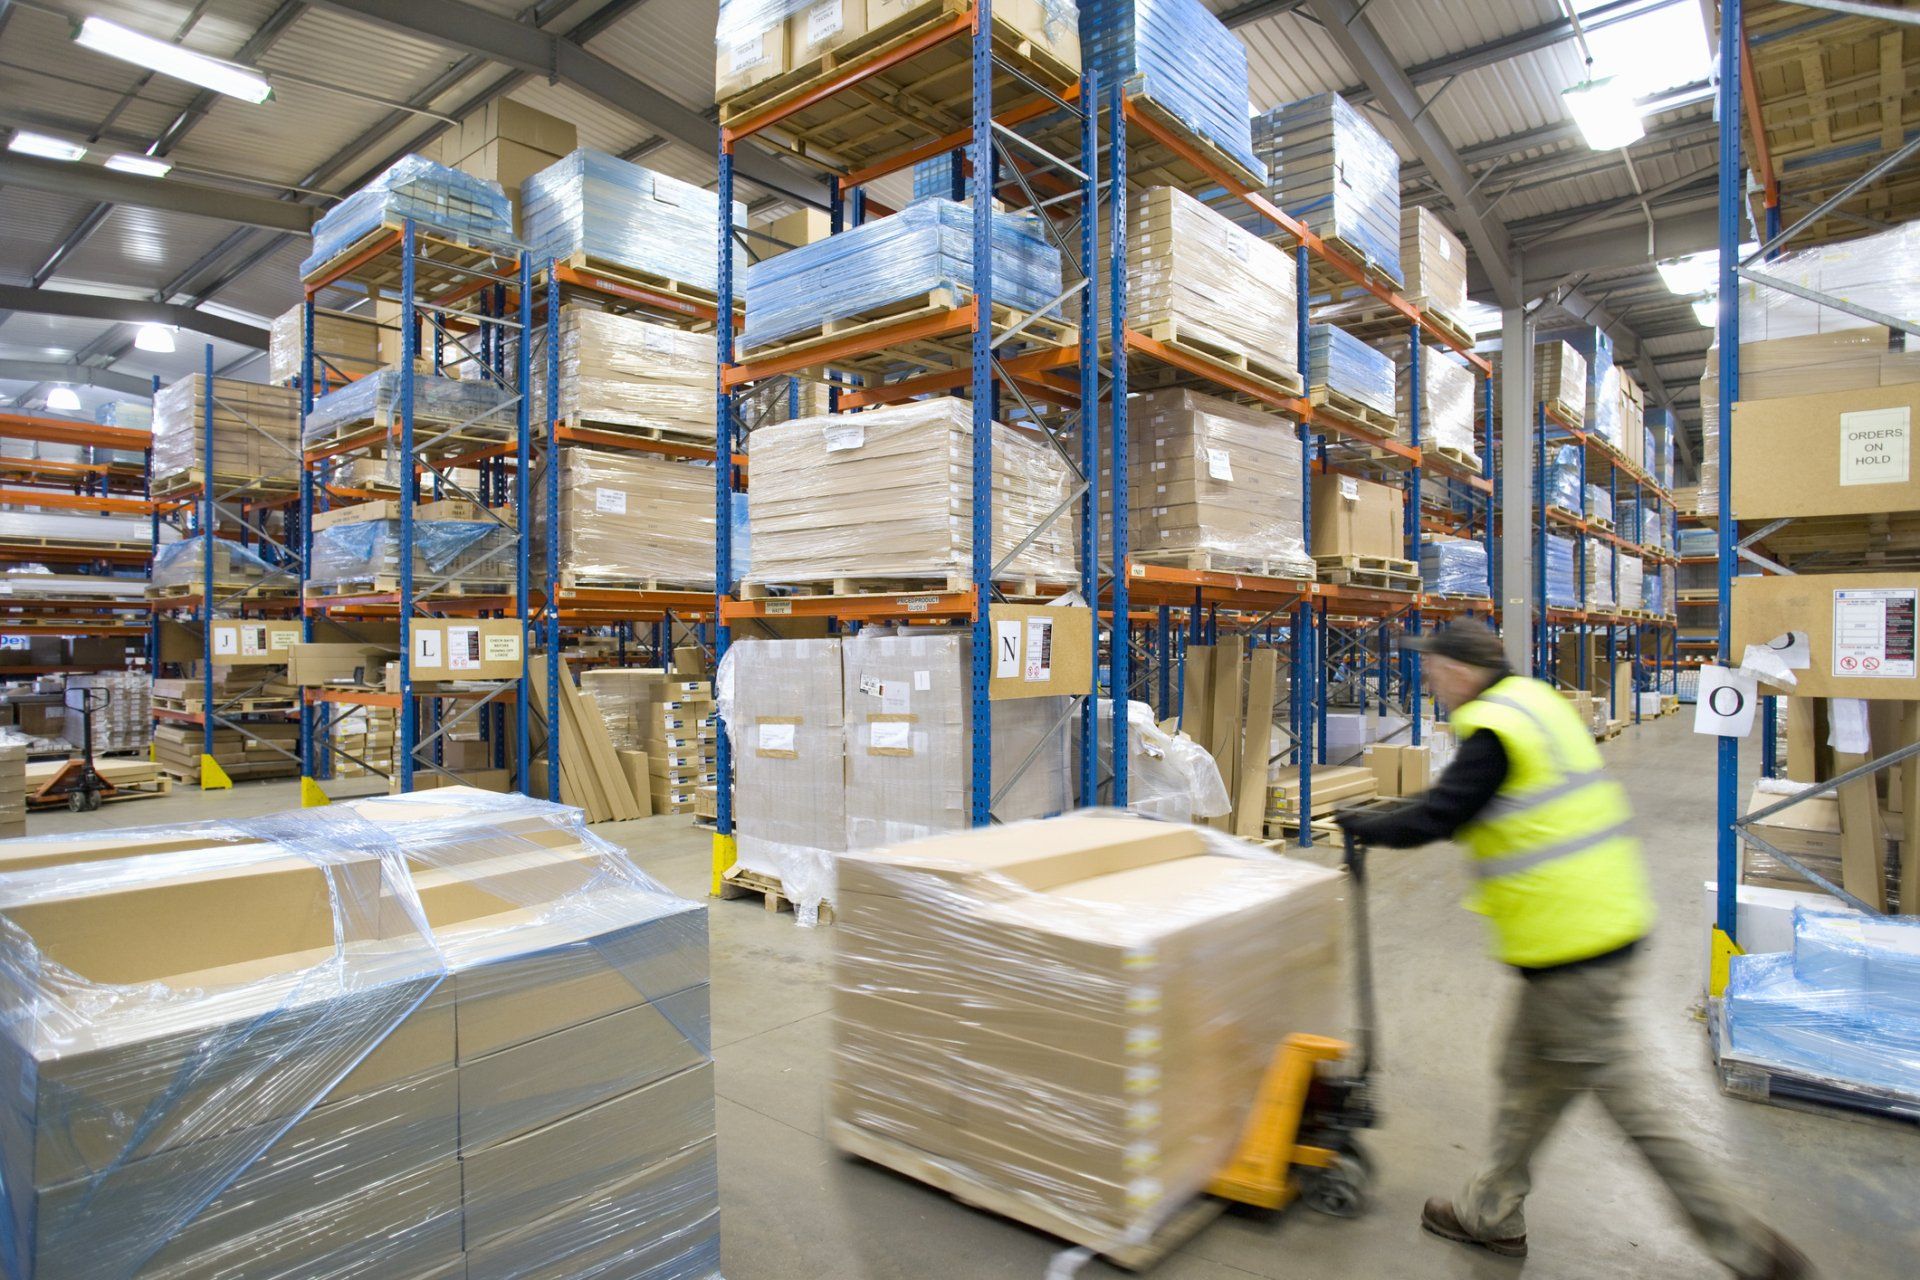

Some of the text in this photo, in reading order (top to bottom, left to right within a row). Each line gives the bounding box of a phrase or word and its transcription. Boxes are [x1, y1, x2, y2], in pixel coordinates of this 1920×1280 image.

[1848, 428, 1903, 441] ORDERS
[1864, 442, 1883, 453] ON
[1855, 455, 1891, 466] HOLD
[222, 635, 228, 648] J
[422, 640, 435, 657] L
[1002, 636, 1016, 661] N
[1709, 686, 1744, 717] O
